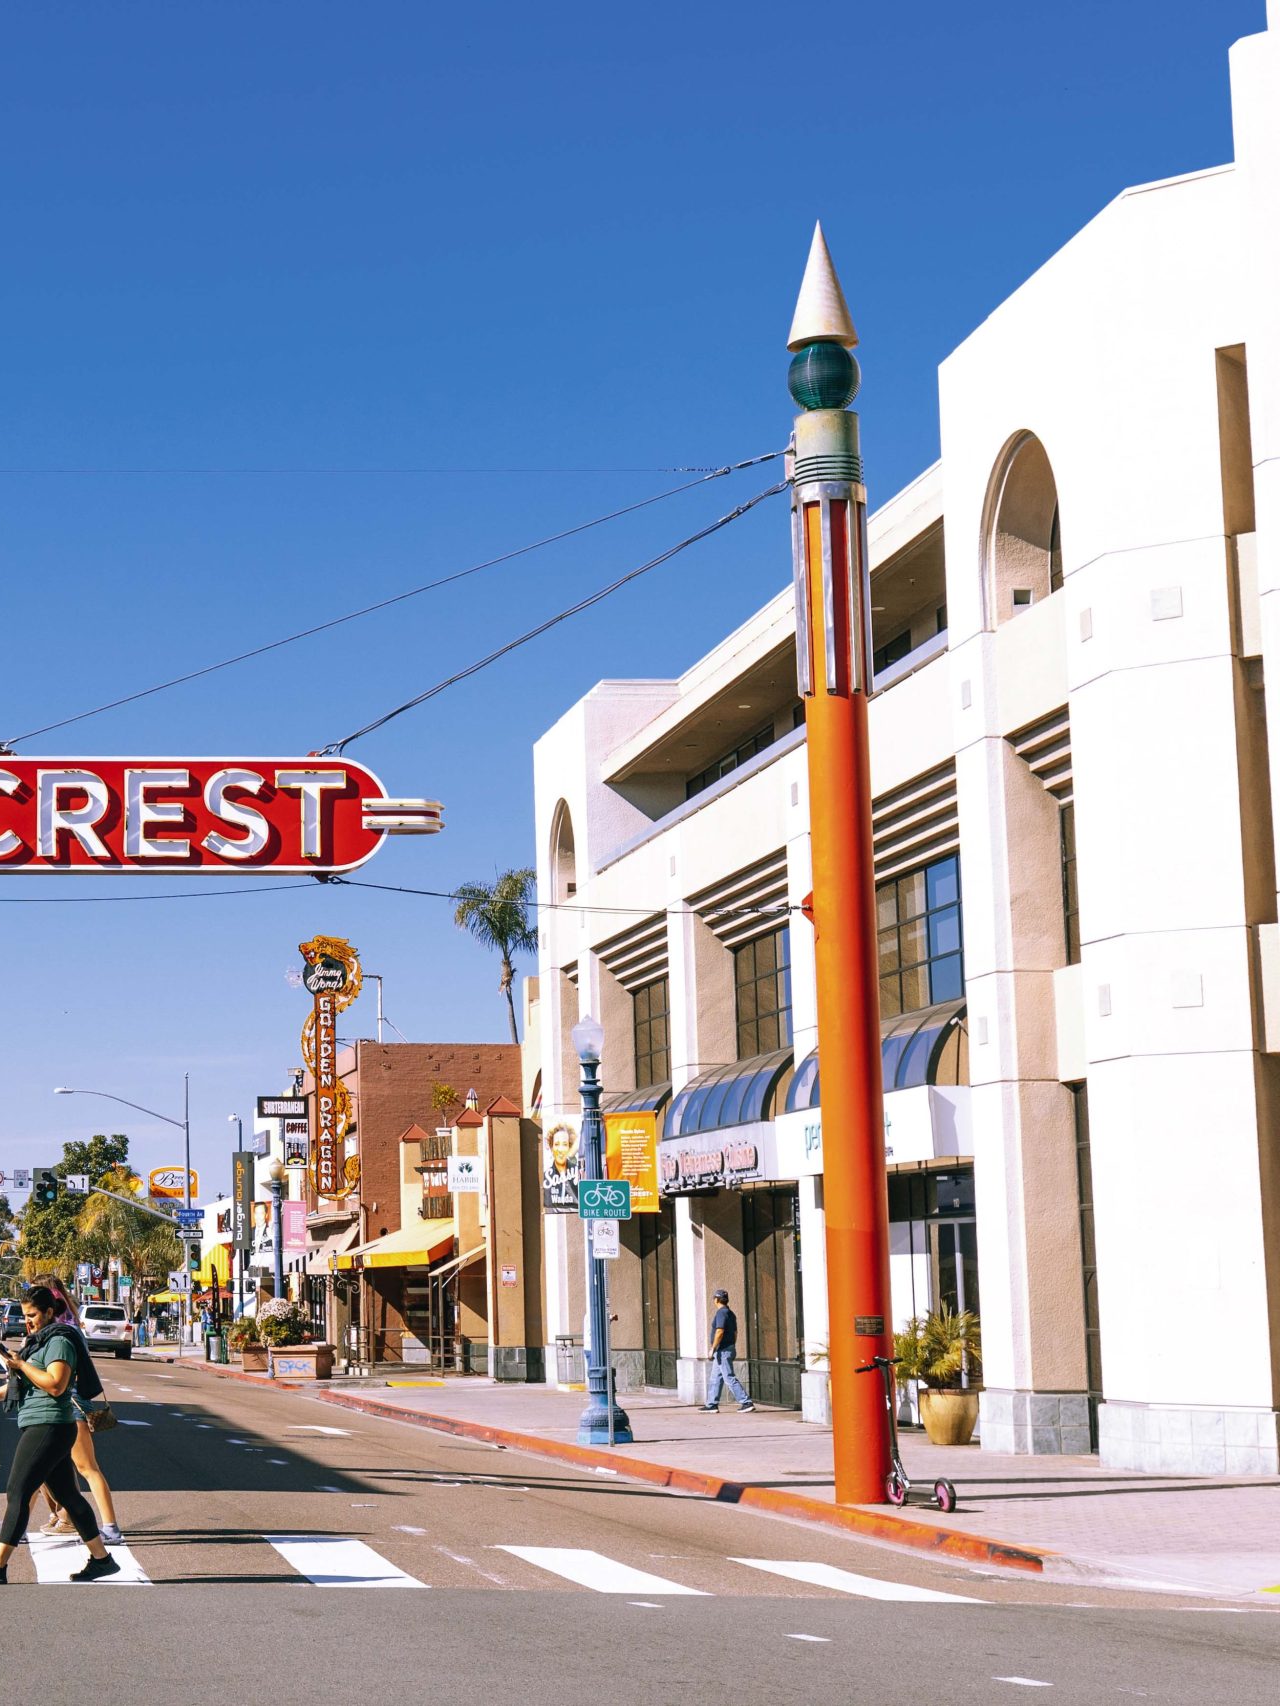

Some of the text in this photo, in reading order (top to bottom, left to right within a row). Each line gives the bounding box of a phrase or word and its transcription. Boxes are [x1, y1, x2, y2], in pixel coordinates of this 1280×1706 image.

[307, 964, 342, 984] Jimmy
[319, 997, 332, 1088] GOLDEN
[263, 1101, 305, 1114] SUBTERRANEAN
[286, 1122, 308, 1134] COFFEE
[319, 1096, 333, 1190] DRAGON
[583, 1209, 626, 1217] BIKE ROUTE
